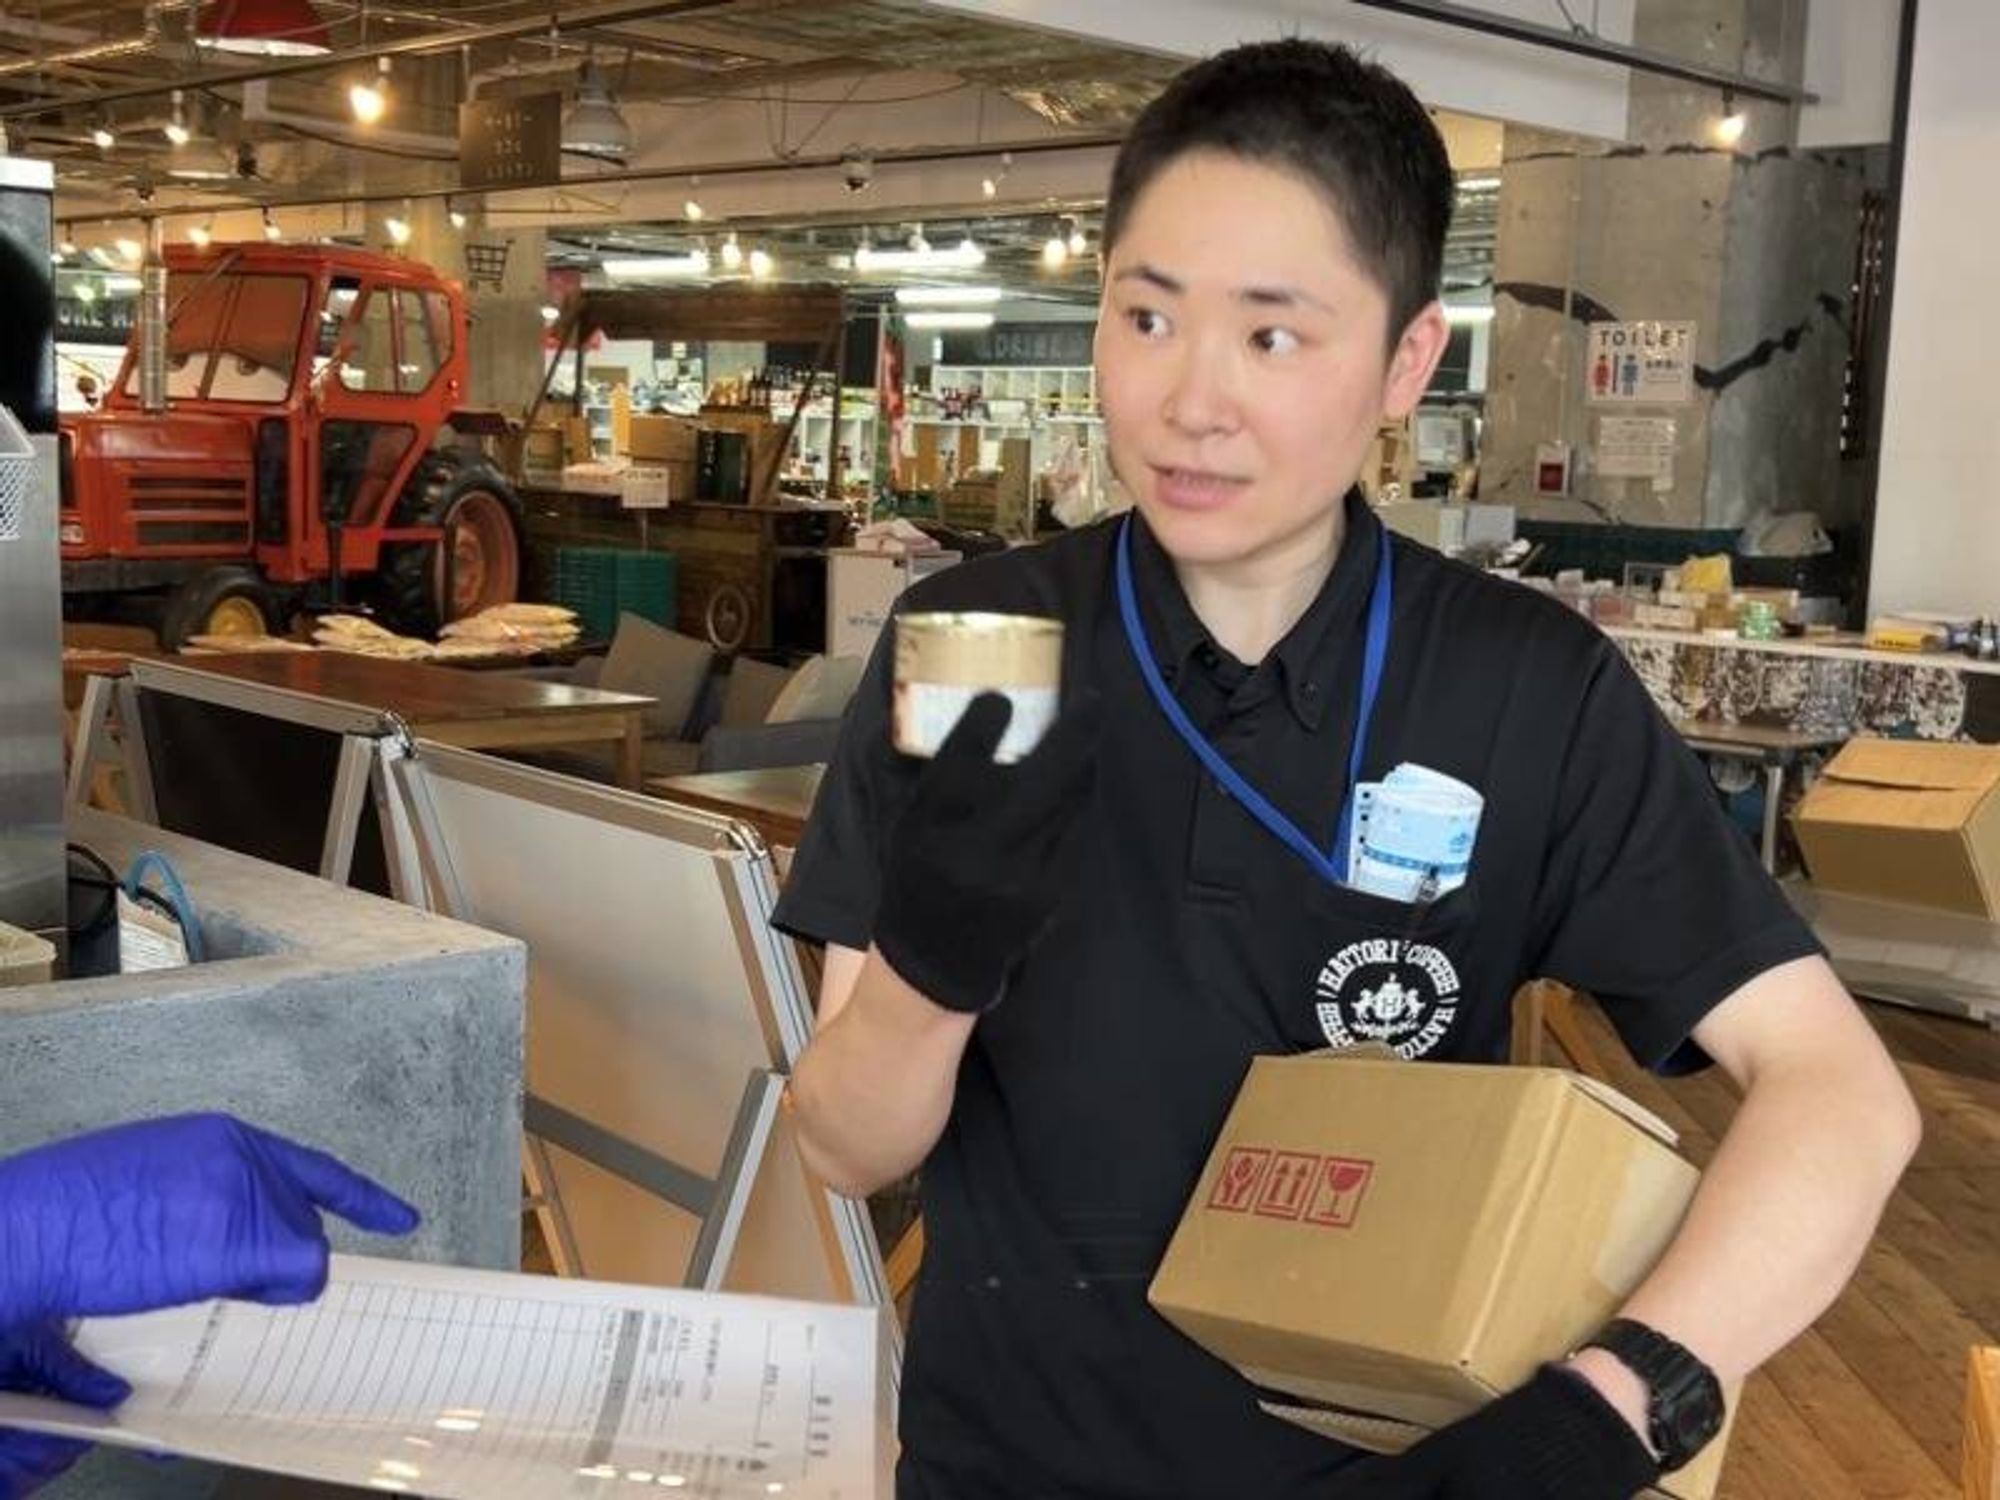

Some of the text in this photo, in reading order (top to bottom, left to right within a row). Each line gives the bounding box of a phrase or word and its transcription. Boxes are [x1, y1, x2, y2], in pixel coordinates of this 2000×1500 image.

[1601, 329, 1687, 346] TOILET
[1317, 938, 1461, 996] HATTORI COFFEE
[1395, 1007, 1457, 1060] HATTO
